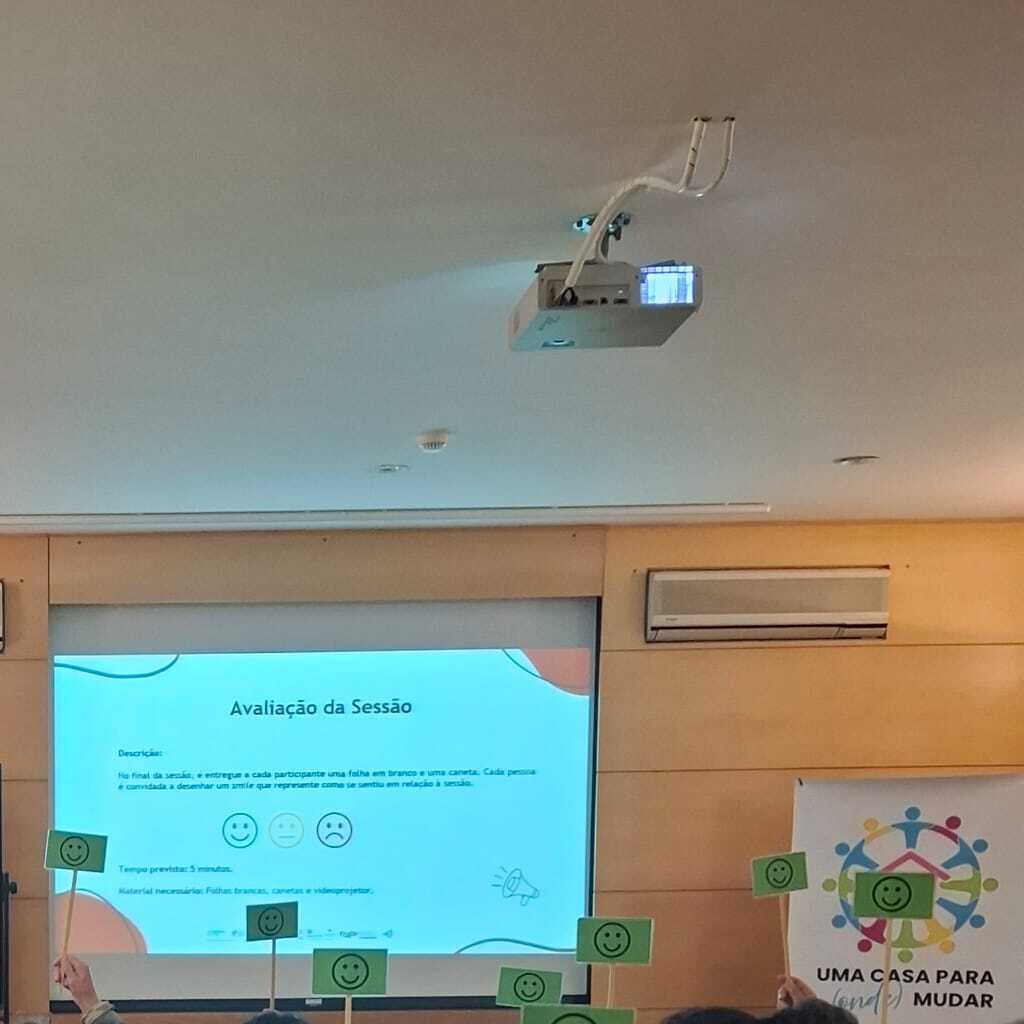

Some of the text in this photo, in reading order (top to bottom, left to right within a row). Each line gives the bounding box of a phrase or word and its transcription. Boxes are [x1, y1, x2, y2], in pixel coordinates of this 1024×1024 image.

[230, 698, 412, 719] Avaliação da Sessão
[132, 771, 150, 779] final
[205, 772, 242, 780] entregue
[274, 771, 325, 779] participante
[126, 782, 167, 790] convidada
[177, 782, 214, 790] desenhar
[256, 782, 271, 791] que
[274, 781, 319, 790] represente
[321, 781, 345, 789] como
[358, 780, 384, 788] sentiu
[402, 779, 434, 788] relação
[118, 864, 147, 874] Tempo
[189, 864, 196, 872] 5
[118, 887, 153, 895] Material
[206, 886, 233, 894] Folhas
[817, 967, 994, 985] UMA CASA PARA
[913, 992, 994, 1008] MUDAR
